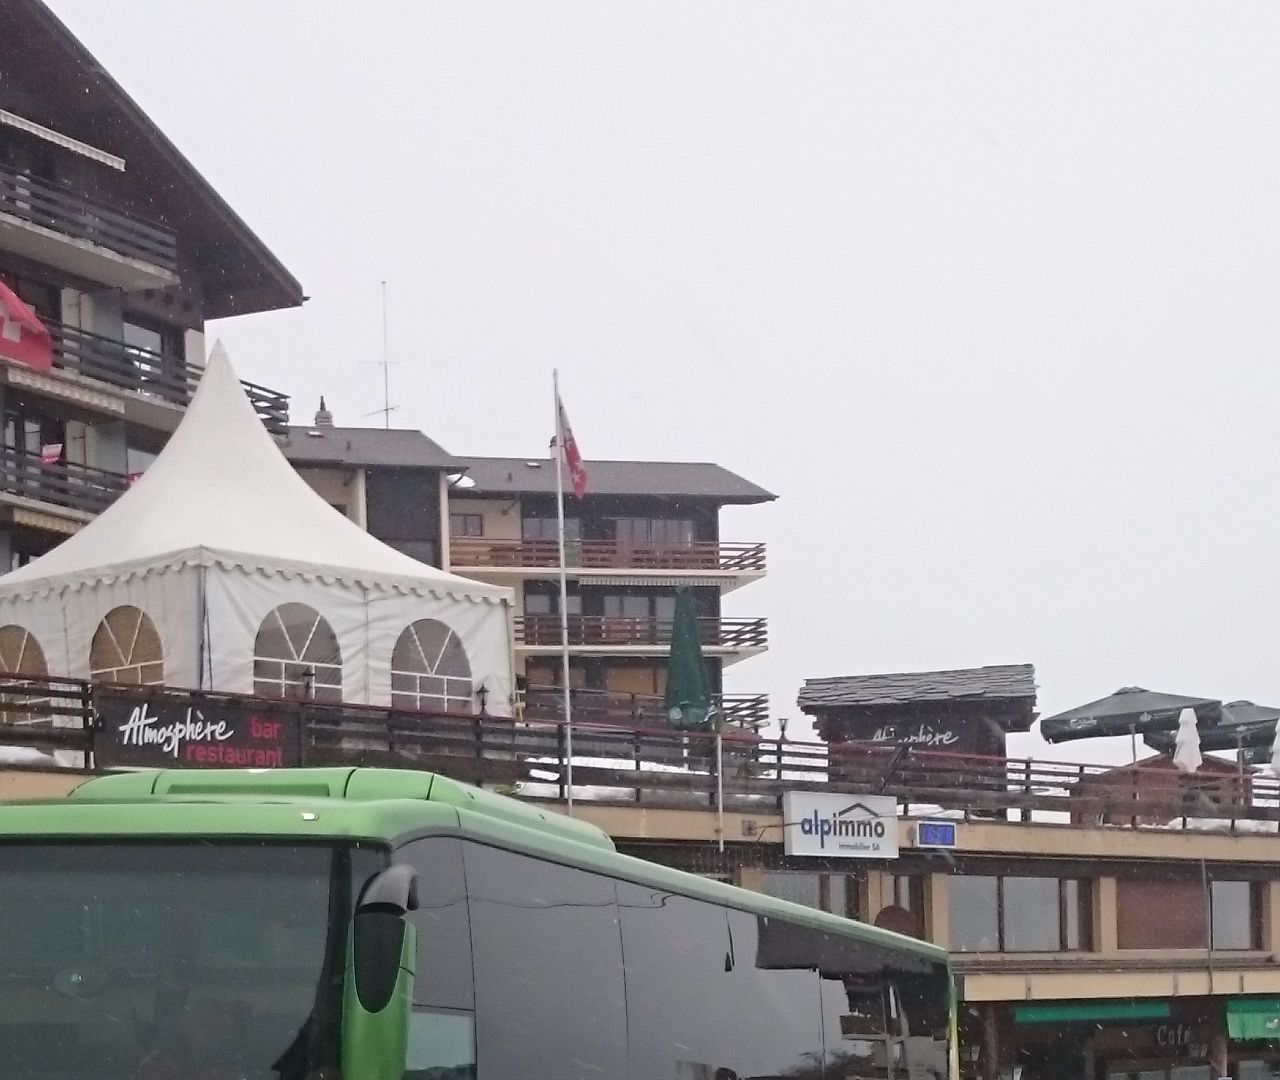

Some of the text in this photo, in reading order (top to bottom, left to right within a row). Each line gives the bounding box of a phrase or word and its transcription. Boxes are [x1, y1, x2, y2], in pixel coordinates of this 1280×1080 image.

[119, 703, 282, 758] Atmosphère bar
[186, 744, 283, 767] restaurant
[801, 809, 885, 848] alpimmo
